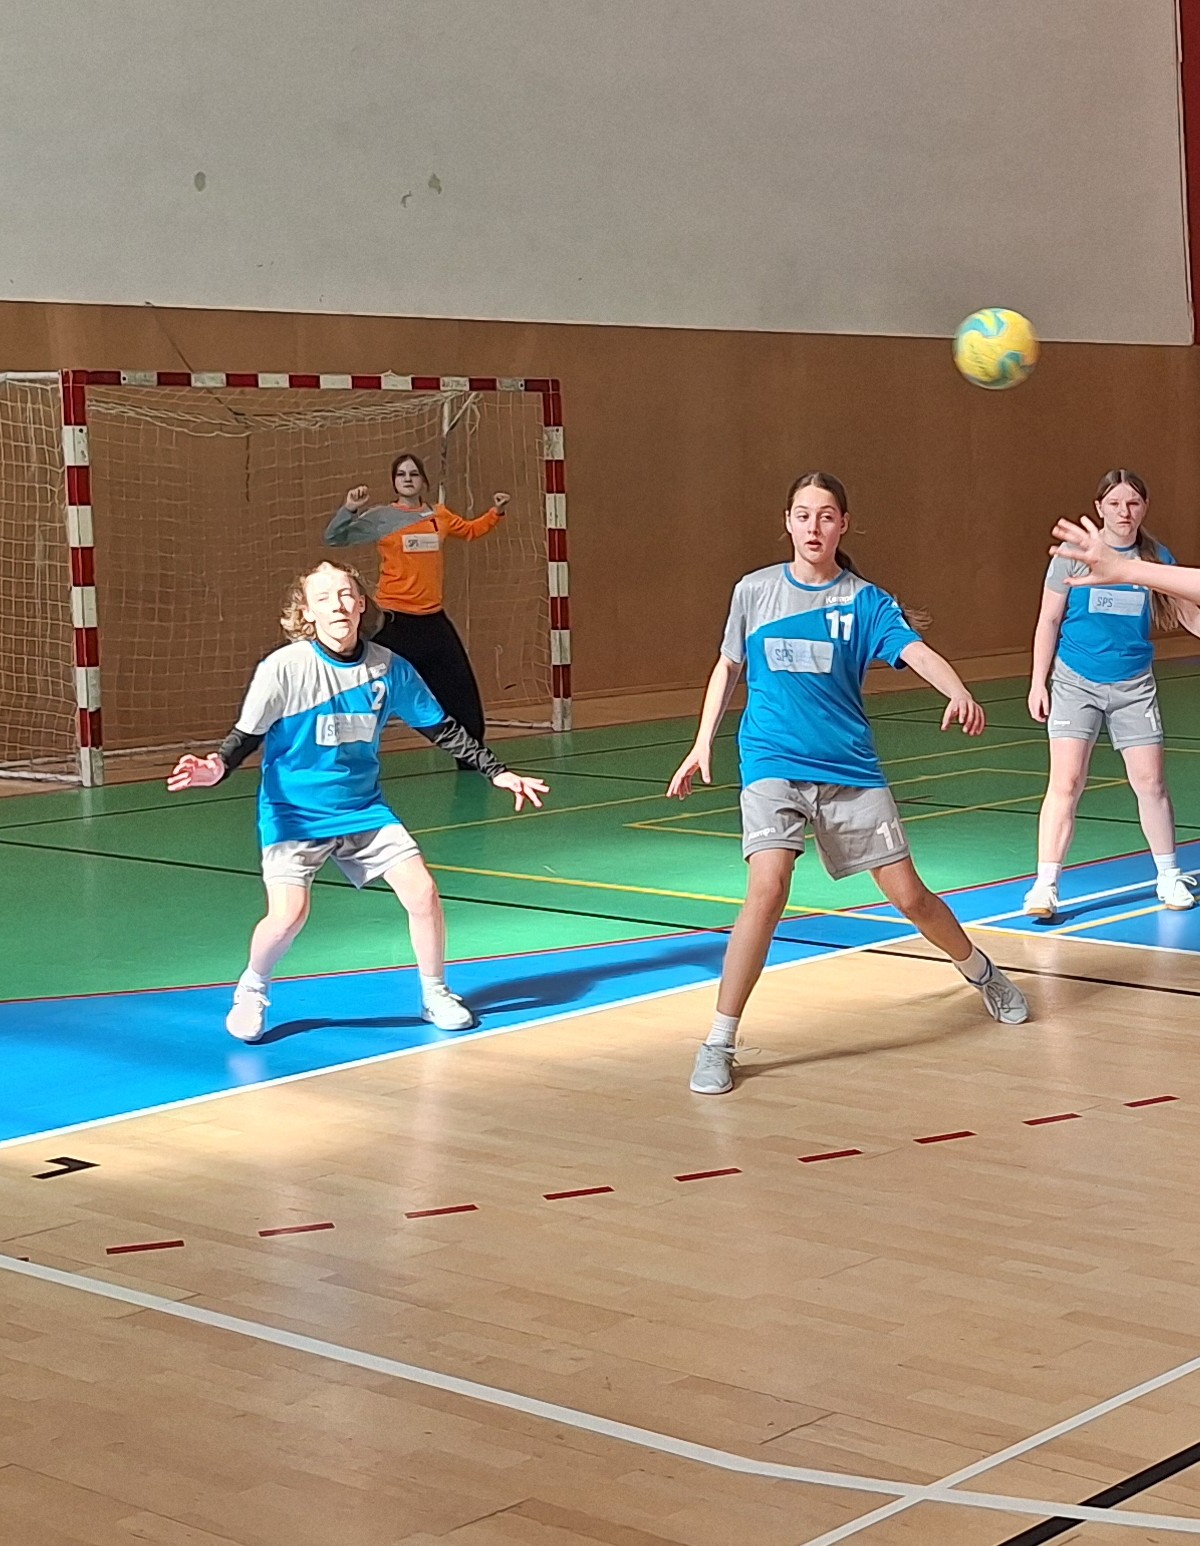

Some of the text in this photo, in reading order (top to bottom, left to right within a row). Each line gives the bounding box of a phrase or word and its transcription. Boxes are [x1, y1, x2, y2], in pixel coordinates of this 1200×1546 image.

[430, 517, 439, 532] 1
[826, 609, 854, 641] 11
[775, 648, 794, 663] SPS
[371, 680, 386, 710] 2
[876, 816, 904, 851] 11
